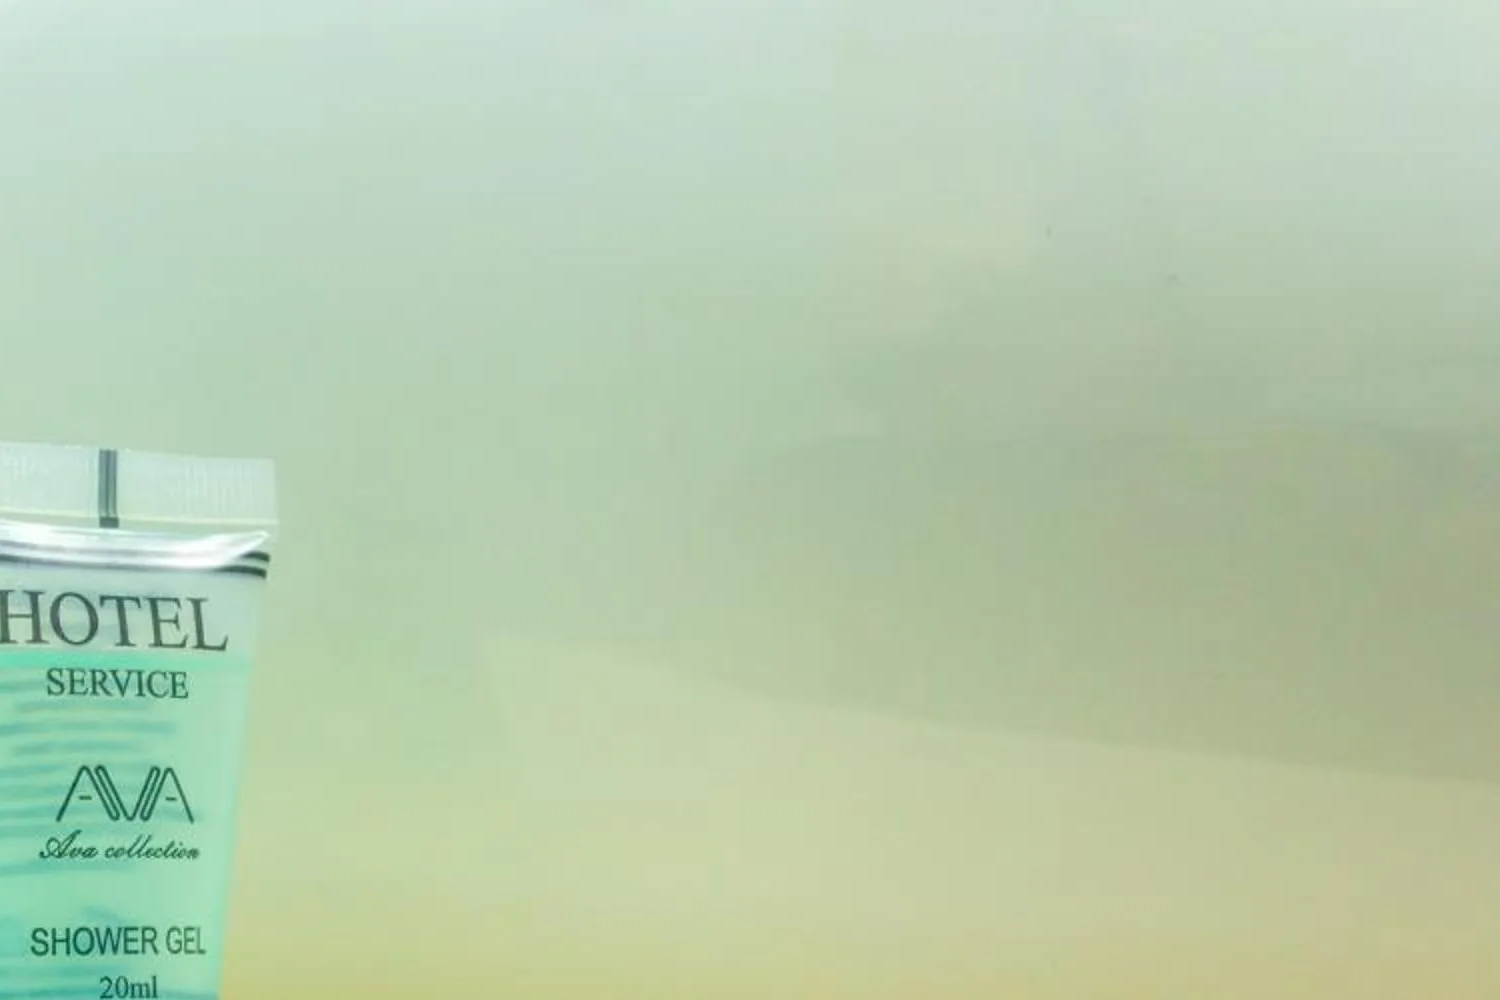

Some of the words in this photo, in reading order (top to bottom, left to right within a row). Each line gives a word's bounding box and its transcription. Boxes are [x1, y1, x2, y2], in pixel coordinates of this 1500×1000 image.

[46, 667, 189, 699] SERVICE
[55, 765, 195, 824] AVA
[38, 829, 99, 859] Ava
[103, 834, 201, 859] collection
[30, 926, 159, 956] SHOWER
[165, 925, 206, 955] GEL
[100, 975, 159, 1000] 20ml
